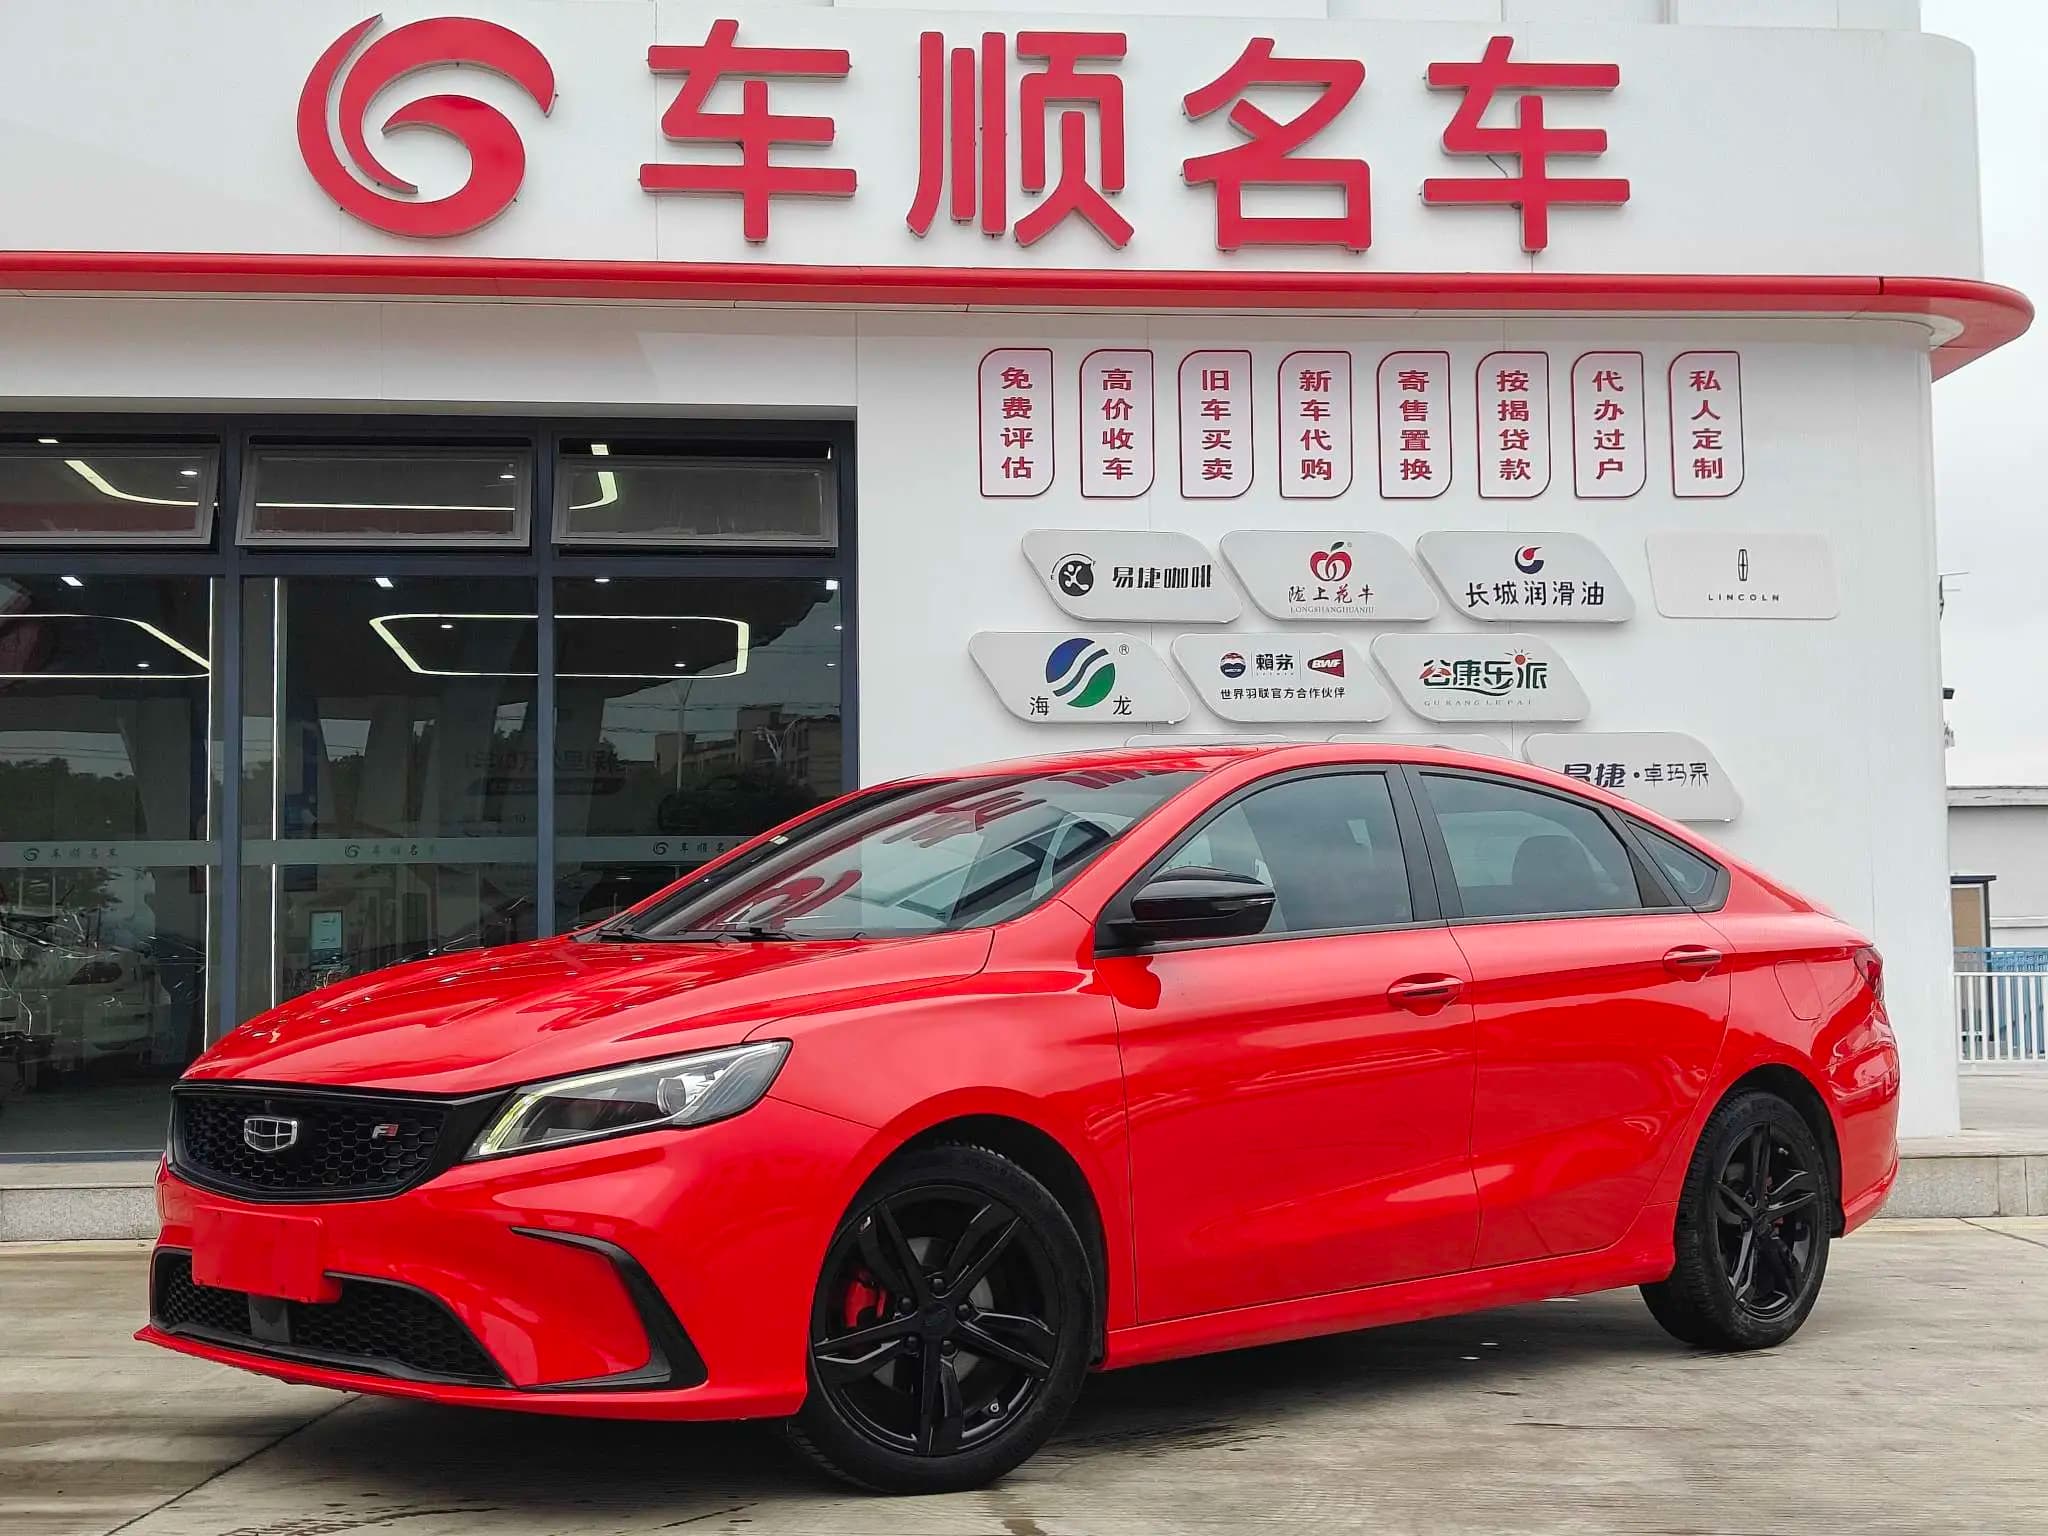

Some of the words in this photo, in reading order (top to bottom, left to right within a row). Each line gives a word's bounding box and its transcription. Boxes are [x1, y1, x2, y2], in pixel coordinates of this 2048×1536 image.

[640, 18, 1631, 254] 车顺名车
[1001, 366, 1033, 479] 免费评估
[1101, 368, 1134, 480] 高价收车
[1201, 369, 1233, 480] 旧车买卖
[1299, 369, 1332, 480] 新车代购
[1398, 370, 1432, 480] 寄售置换
[1496, 370, 1531, 480] 按揭贷款
[1592, 370, 1625, 480] 代办过户
[1689, 370, 1723, 479] 私人定制
[1112, 564, 1211, 588] 易捷咖啡
[1288, 583, 1374, 605] 陇上花牛
[1465, 580, 1605, 608] 长城润滑油
[1708, 593, 1780, 602] LINCOLN
[1220, 687, 1345, 700] 世界羽联官方合作伙伴
[1419, 659, 1548, 689] 谷康乐派
